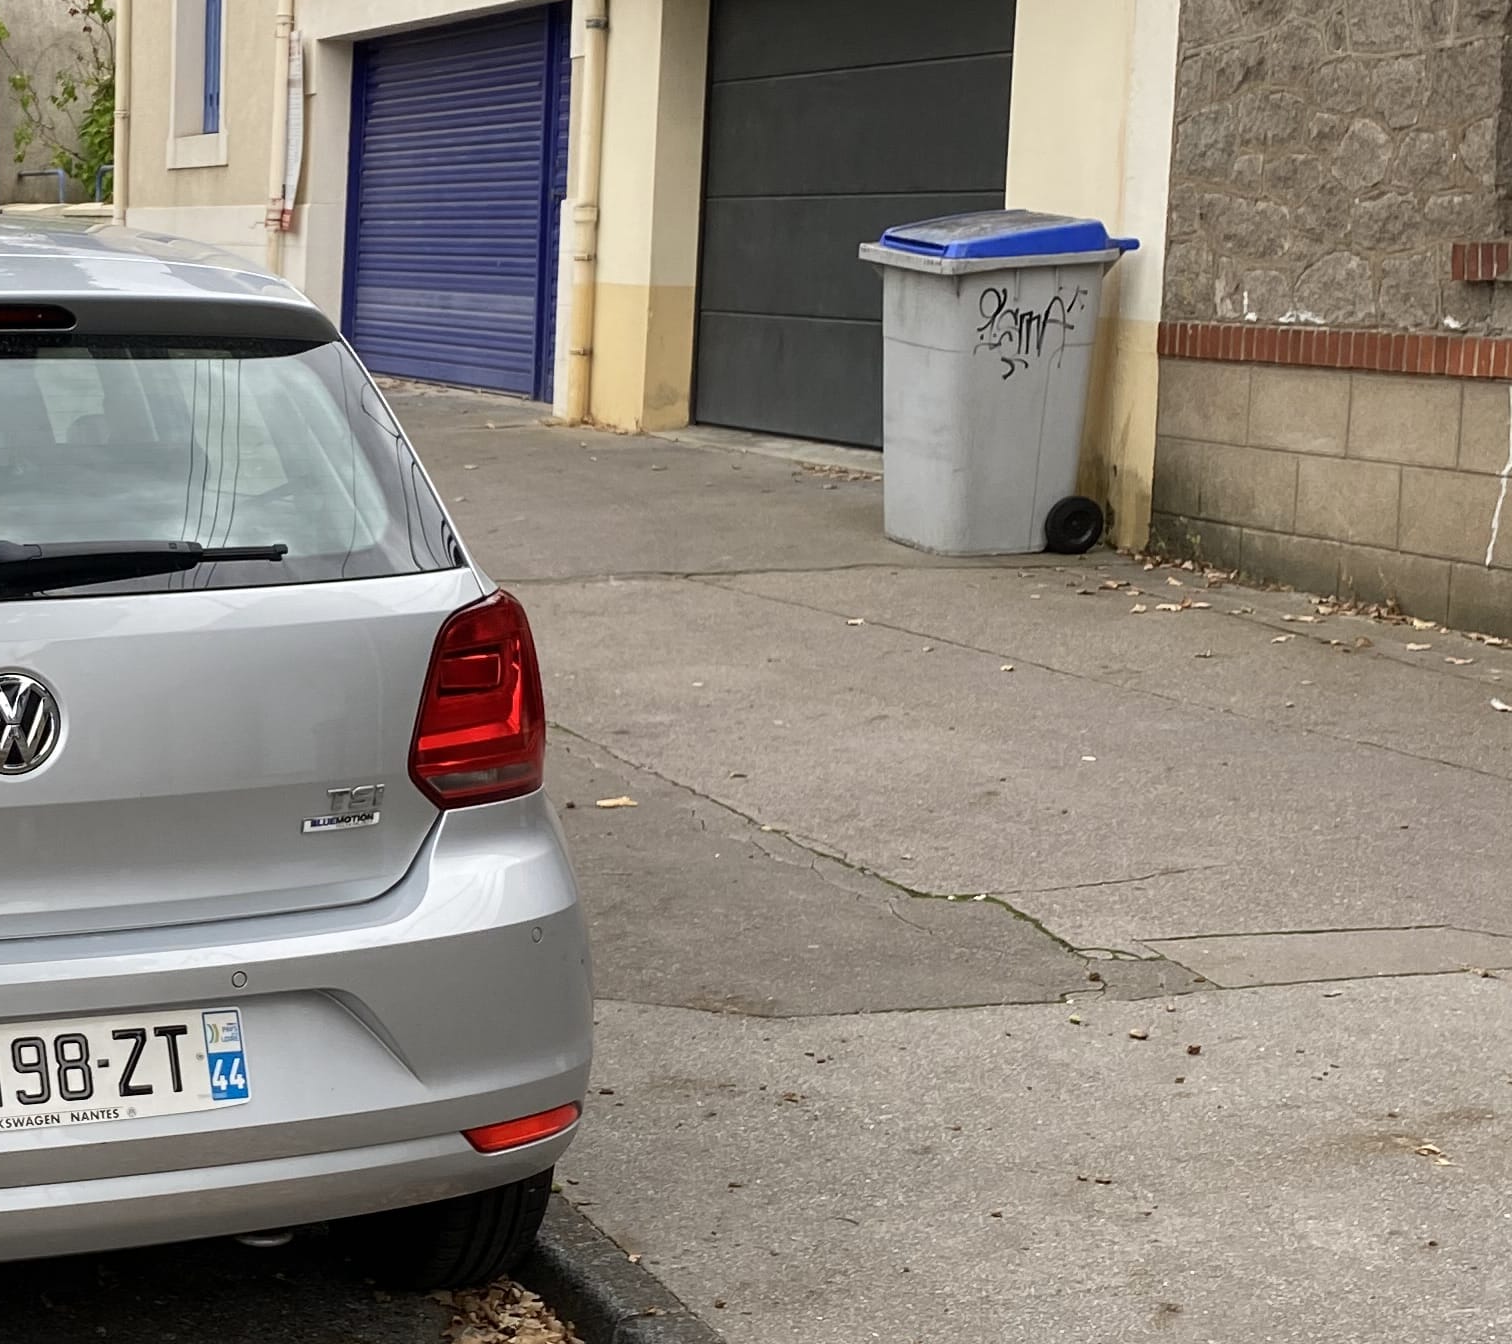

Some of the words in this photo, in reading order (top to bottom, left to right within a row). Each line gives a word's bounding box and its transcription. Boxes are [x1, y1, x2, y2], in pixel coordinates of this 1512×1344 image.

[327, 784, 385, 811] TSI
[211, 1057, 246, 1090] 44
[70, 1108, 120, 1123] NANTES
